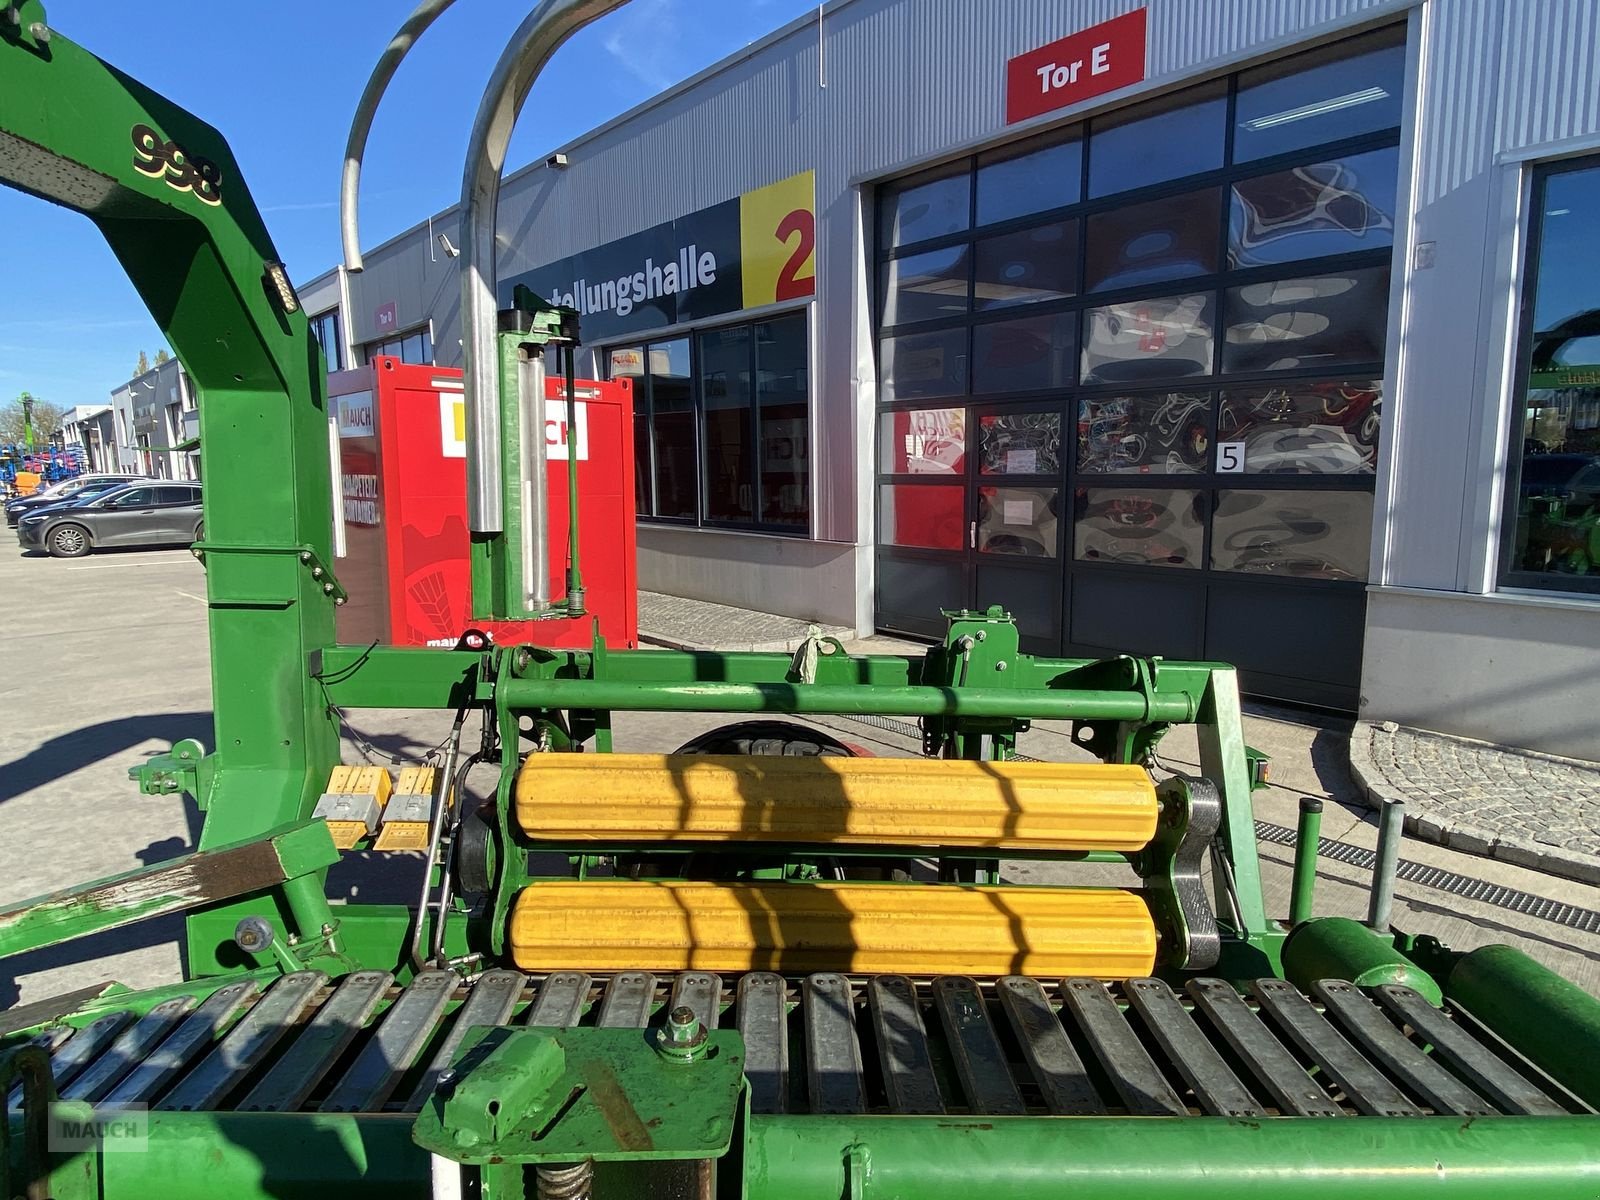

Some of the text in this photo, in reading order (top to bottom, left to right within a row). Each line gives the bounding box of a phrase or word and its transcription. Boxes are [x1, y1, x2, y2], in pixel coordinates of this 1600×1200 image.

[1037, 42, 1110, 94] Tor E
[130, 122, 222, 206] 998
[774, 208, 815, 302] 2
[1222, 446, 1238, 471] 5
